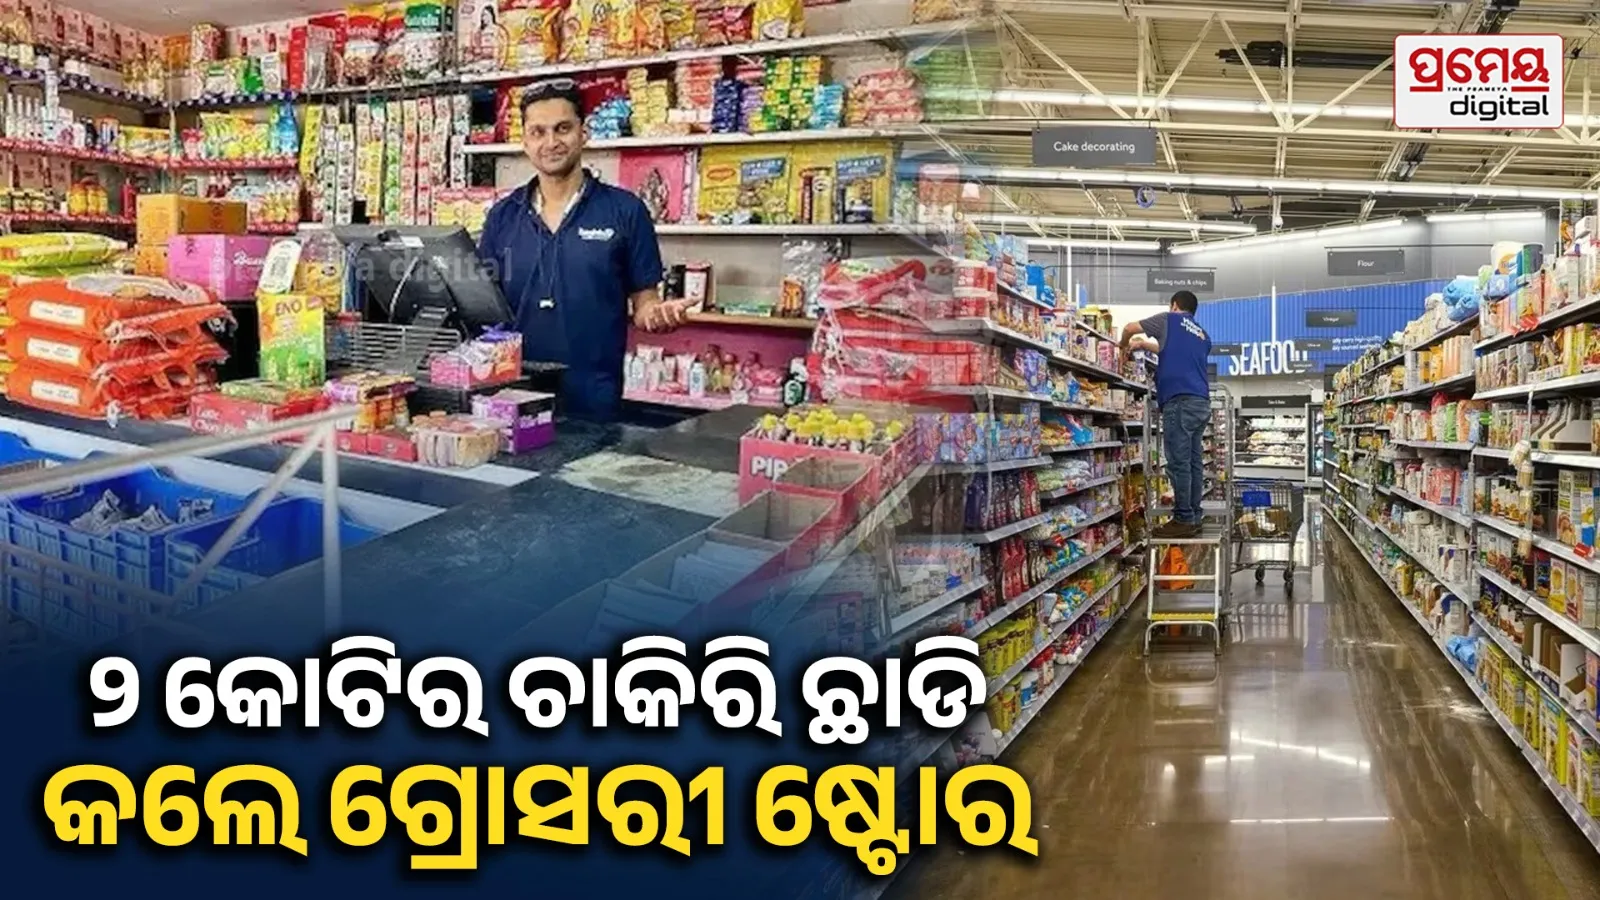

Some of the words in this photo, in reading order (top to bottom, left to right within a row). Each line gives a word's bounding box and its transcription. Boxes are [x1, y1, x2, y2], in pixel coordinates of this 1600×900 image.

[1053, 141, 1079, 152] Cake
[1081, 141, 1136, 154] decorating
[1357, 259, 1374, 267] Flour
[1154, 278, 1173, 287] Baking
[1192, 279, 1208, 287] chips
